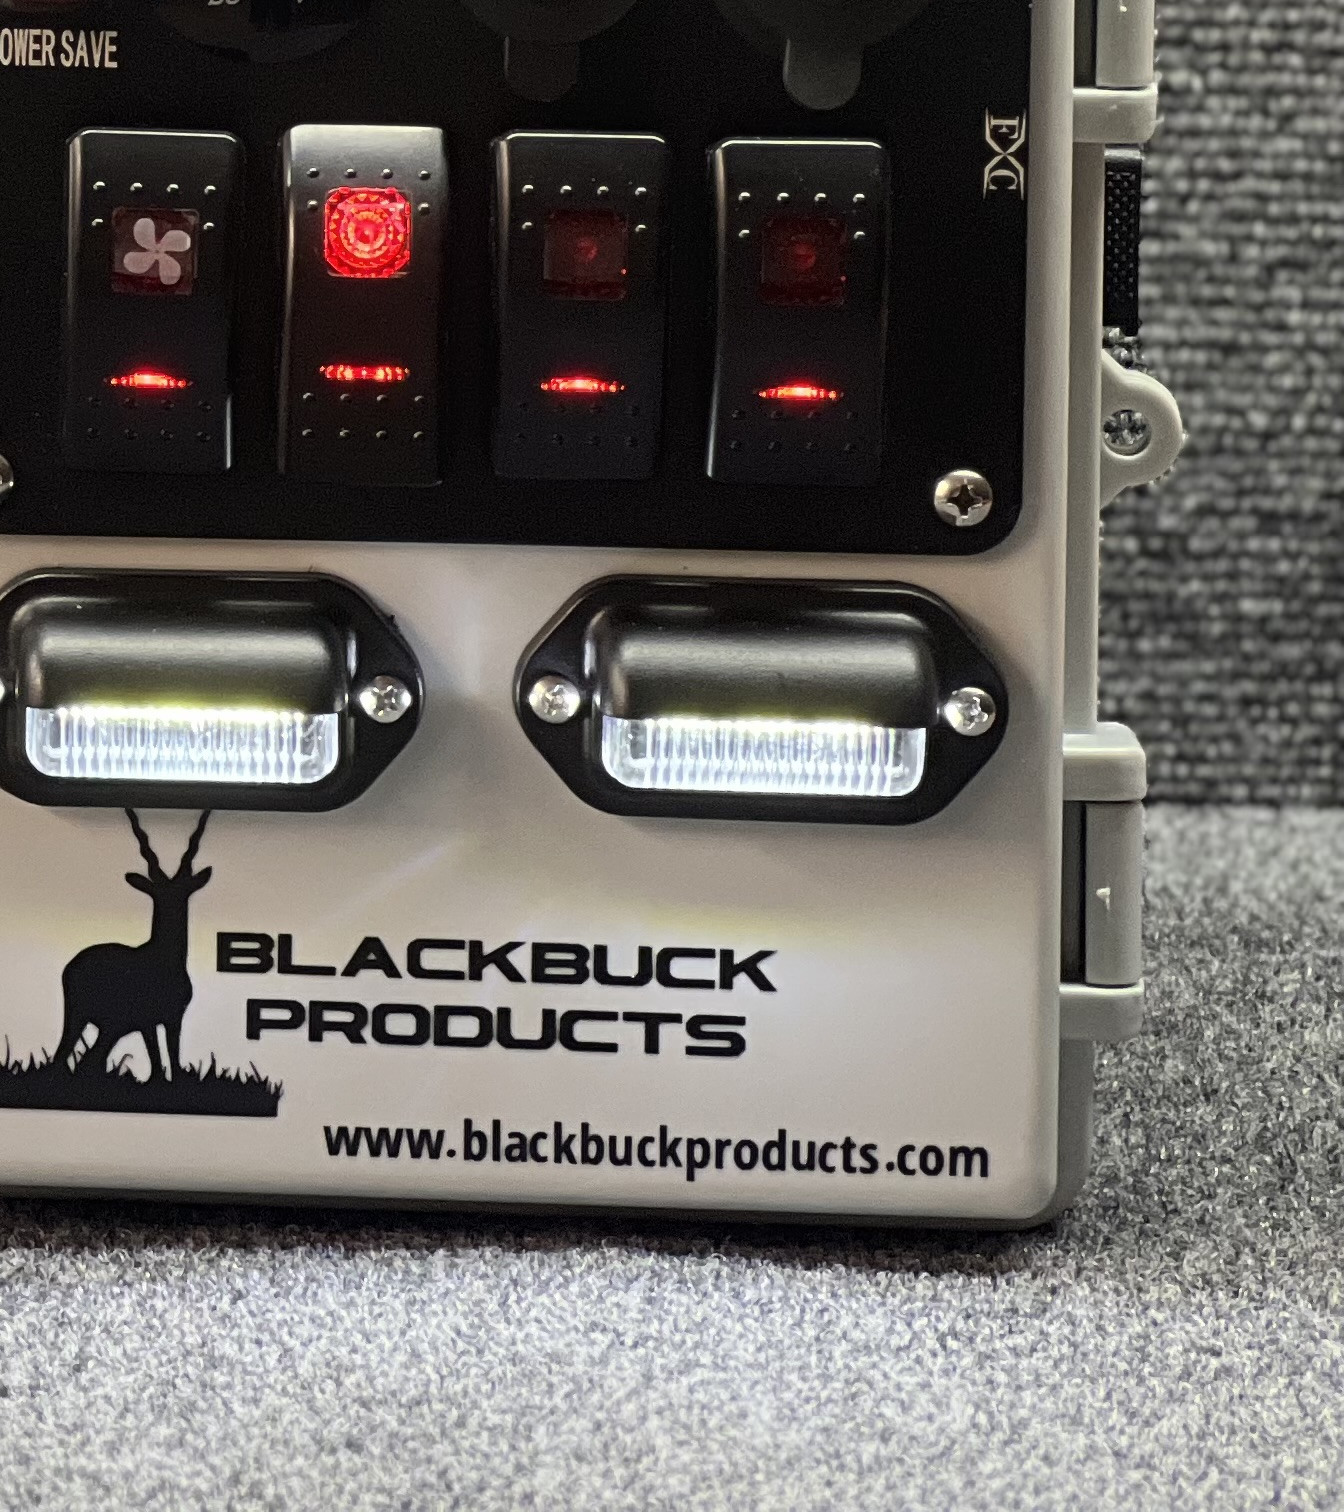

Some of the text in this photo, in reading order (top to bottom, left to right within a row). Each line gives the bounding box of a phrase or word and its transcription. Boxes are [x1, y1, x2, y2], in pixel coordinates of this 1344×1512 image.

[60, 29, 118, 68] SAVE
[216, 931, 778, 993] BLACKBUCK
[246, 999, 746, 1059] PRODUCTS
[323, 1120, 989, 1181] www.blackbuckproducts.com
